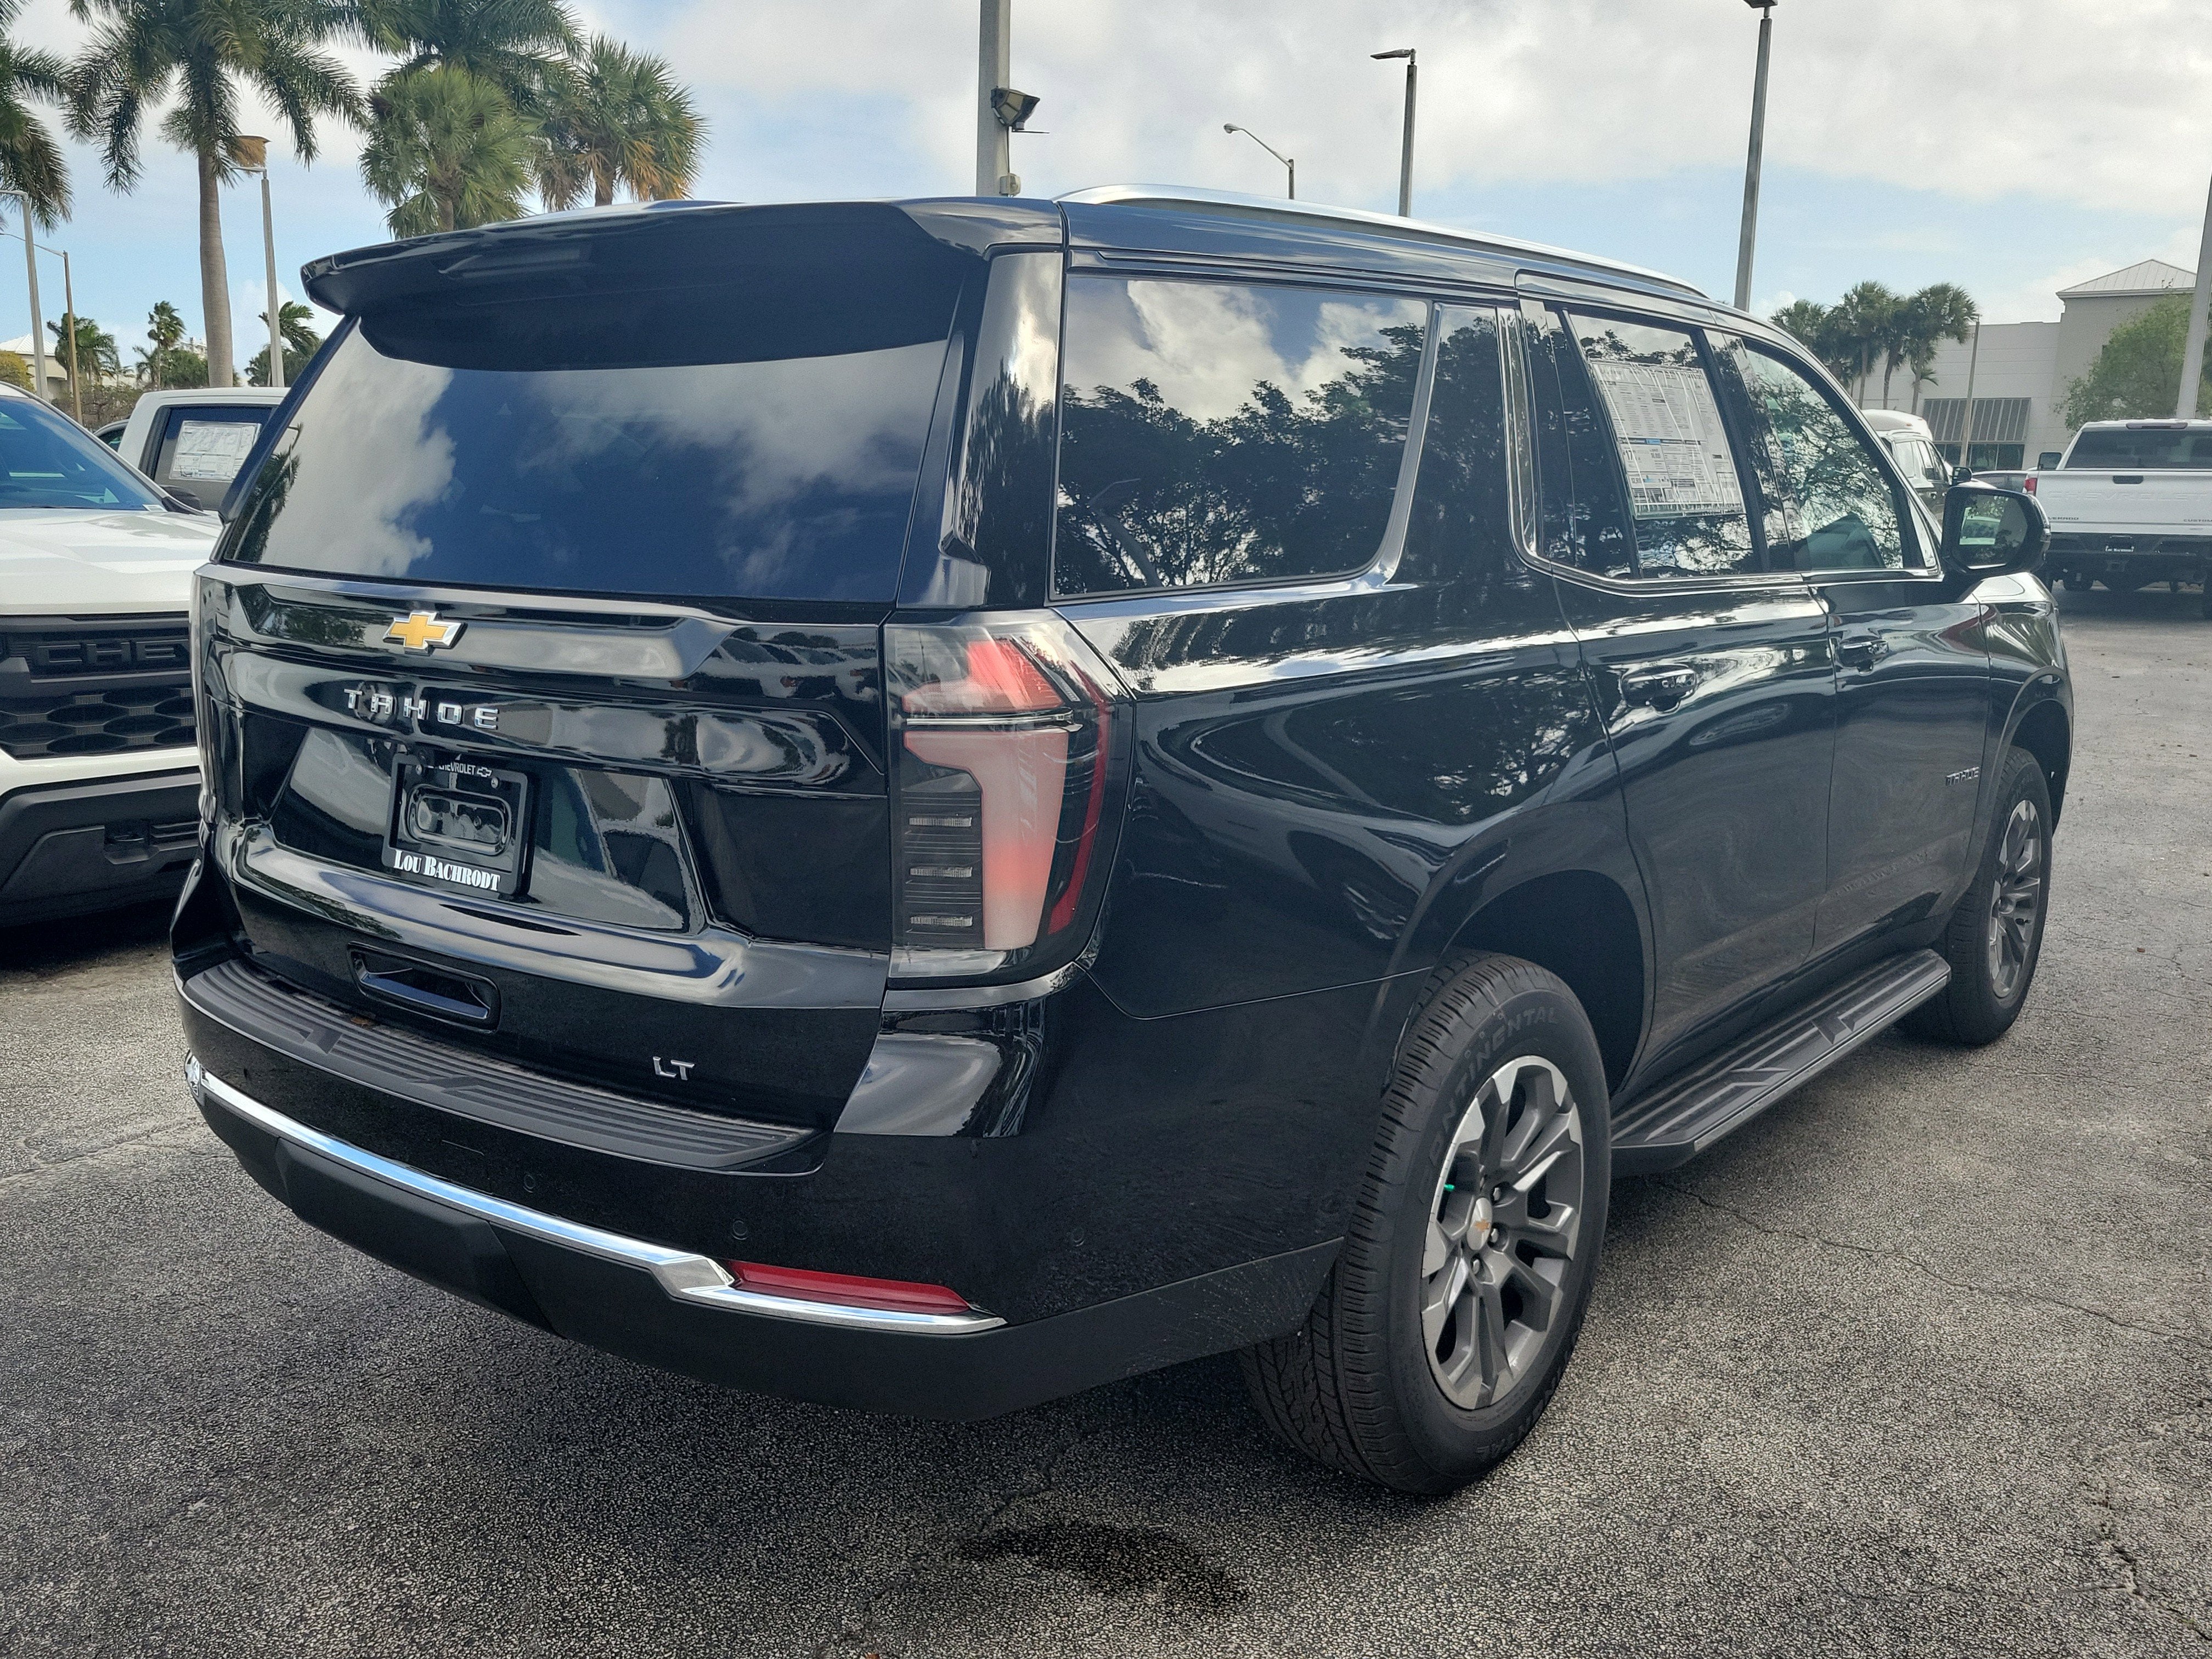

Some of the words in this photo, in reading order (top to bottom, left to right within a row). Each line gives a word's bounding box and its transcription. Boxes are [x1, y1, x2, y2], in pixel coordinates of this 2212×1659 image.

[344, 689, 499, 729] TAHOE
[424, 856, 500, 891] BACHRODT
[653, 1056, 695, 1080] LT
